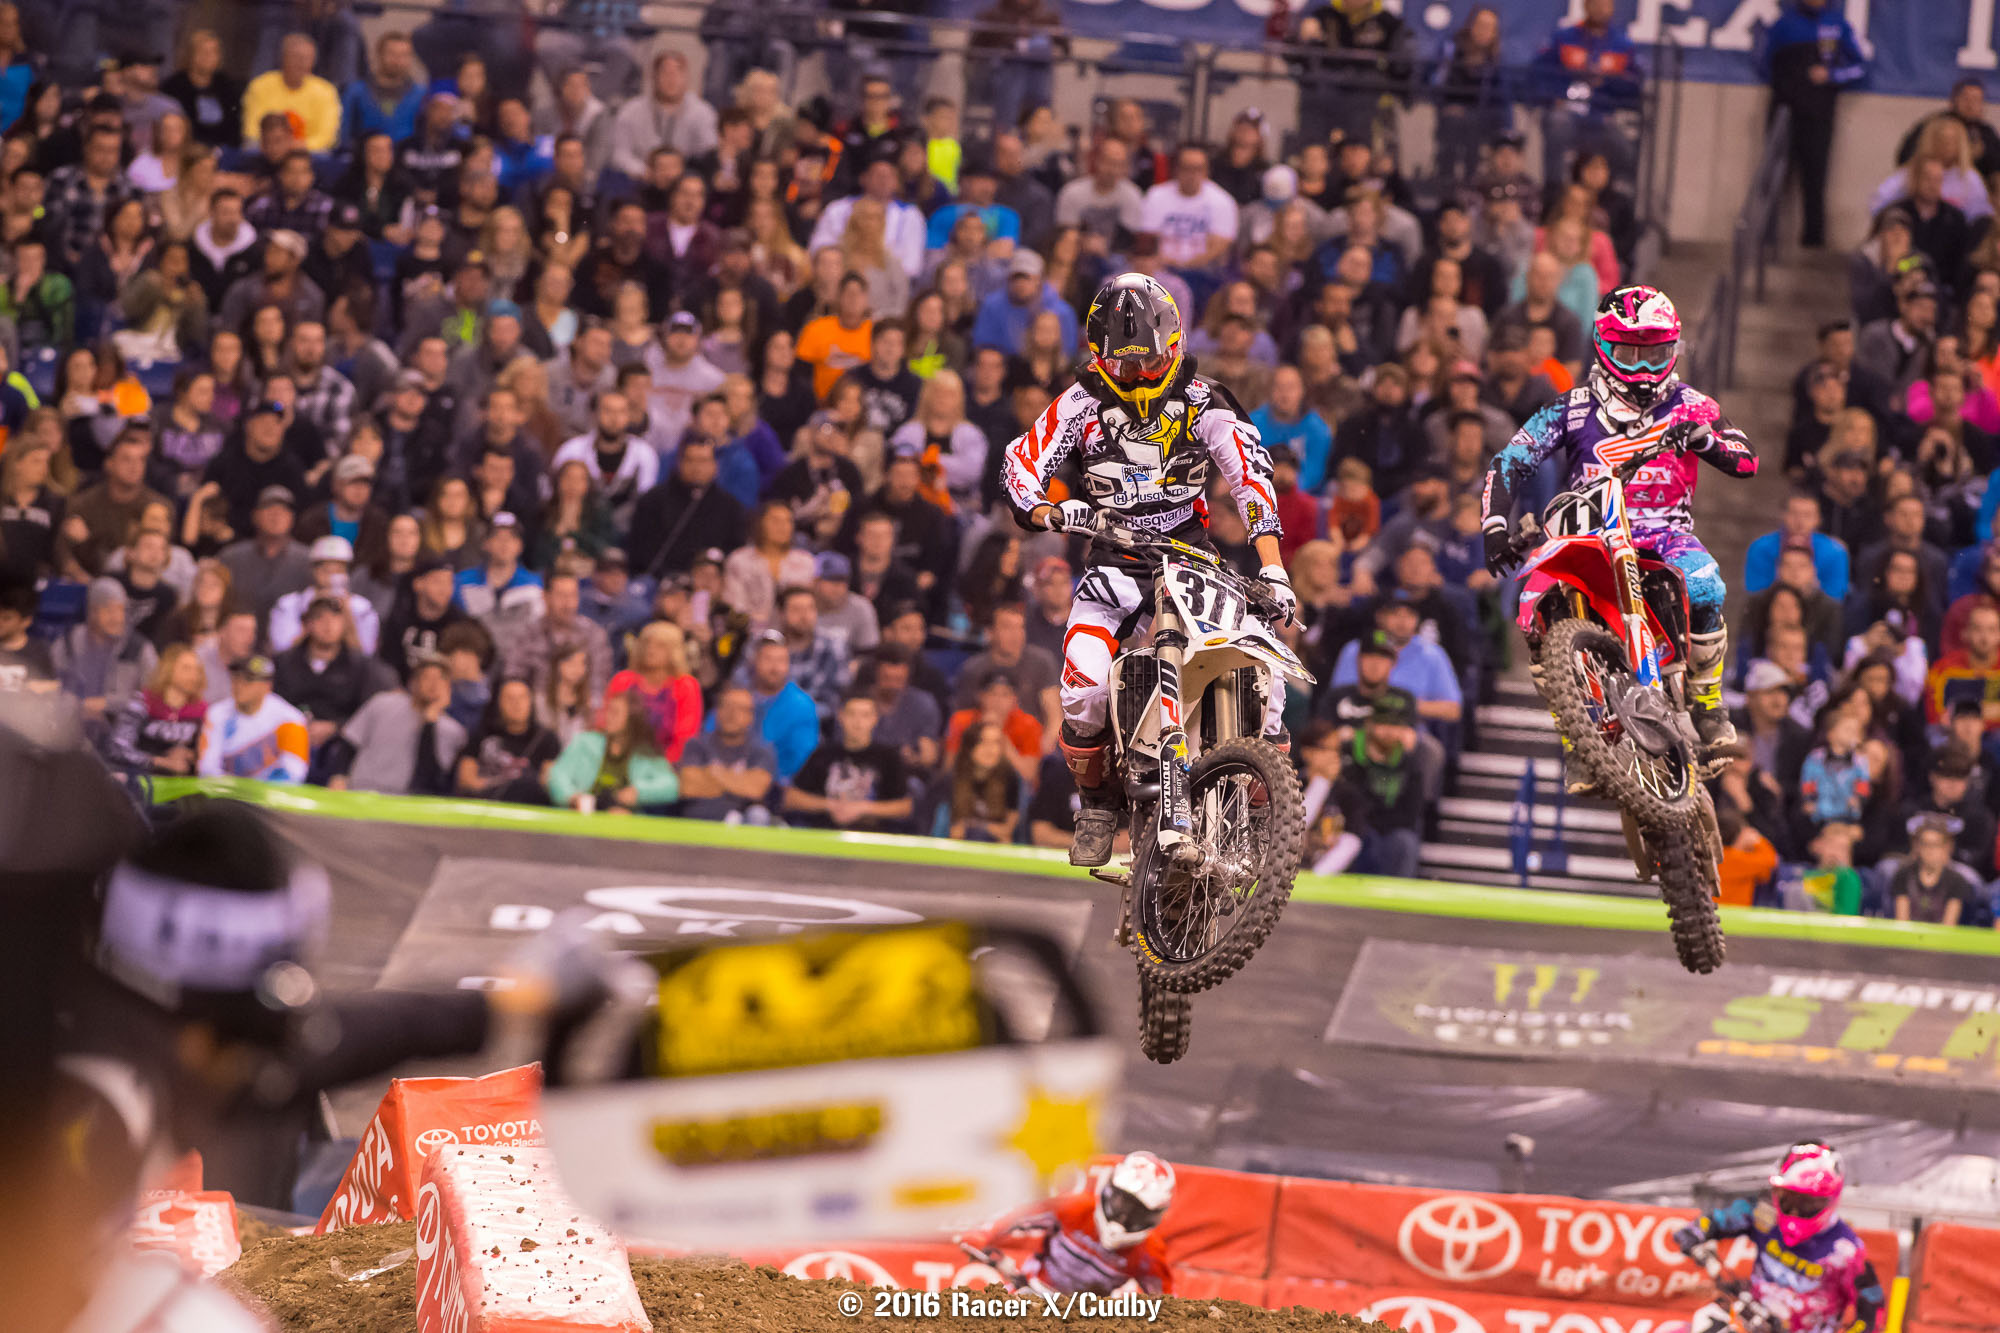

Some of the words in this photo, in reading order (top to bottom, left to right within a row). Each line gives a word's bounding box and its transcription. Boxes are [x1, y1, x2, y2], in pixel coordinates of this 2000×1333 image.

[1131, 486, 1189, 502] Husqvarna
[1642, 629, 1658, 677] DUNLOP
[1162, 760, 1172, 818] DUNLOP
[1137, 932, 1163, 965] DUNLOP
[461, 1119, 543, 1142] TOYOTA
[1536, 1207, 1758, 1270] TOYOA
[1537, 1259, 1607, 1292] Let's
[1615, 1267, 1660, 1297] Go
